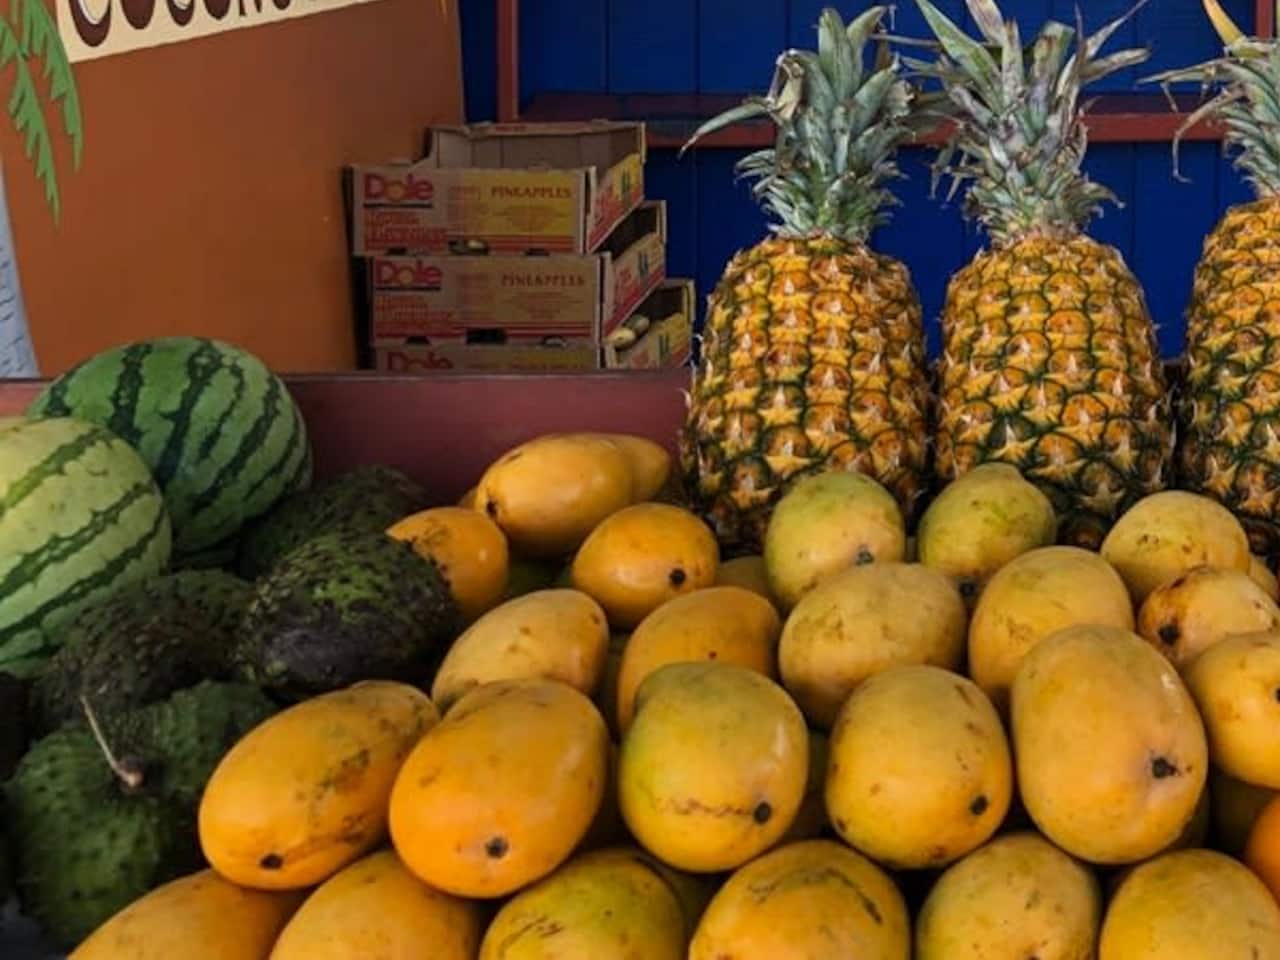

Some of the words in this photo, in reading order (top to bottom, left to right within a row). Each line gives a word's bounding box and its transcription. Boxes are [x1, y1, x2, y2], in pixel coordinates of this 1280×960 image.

[363, 173, 434, 200] Dole
[491, 185, 571, 199] PINEAPPLES
[375, 258, 442, 286] Dole
[502, 272, 586, 287] PINEAPPLES
